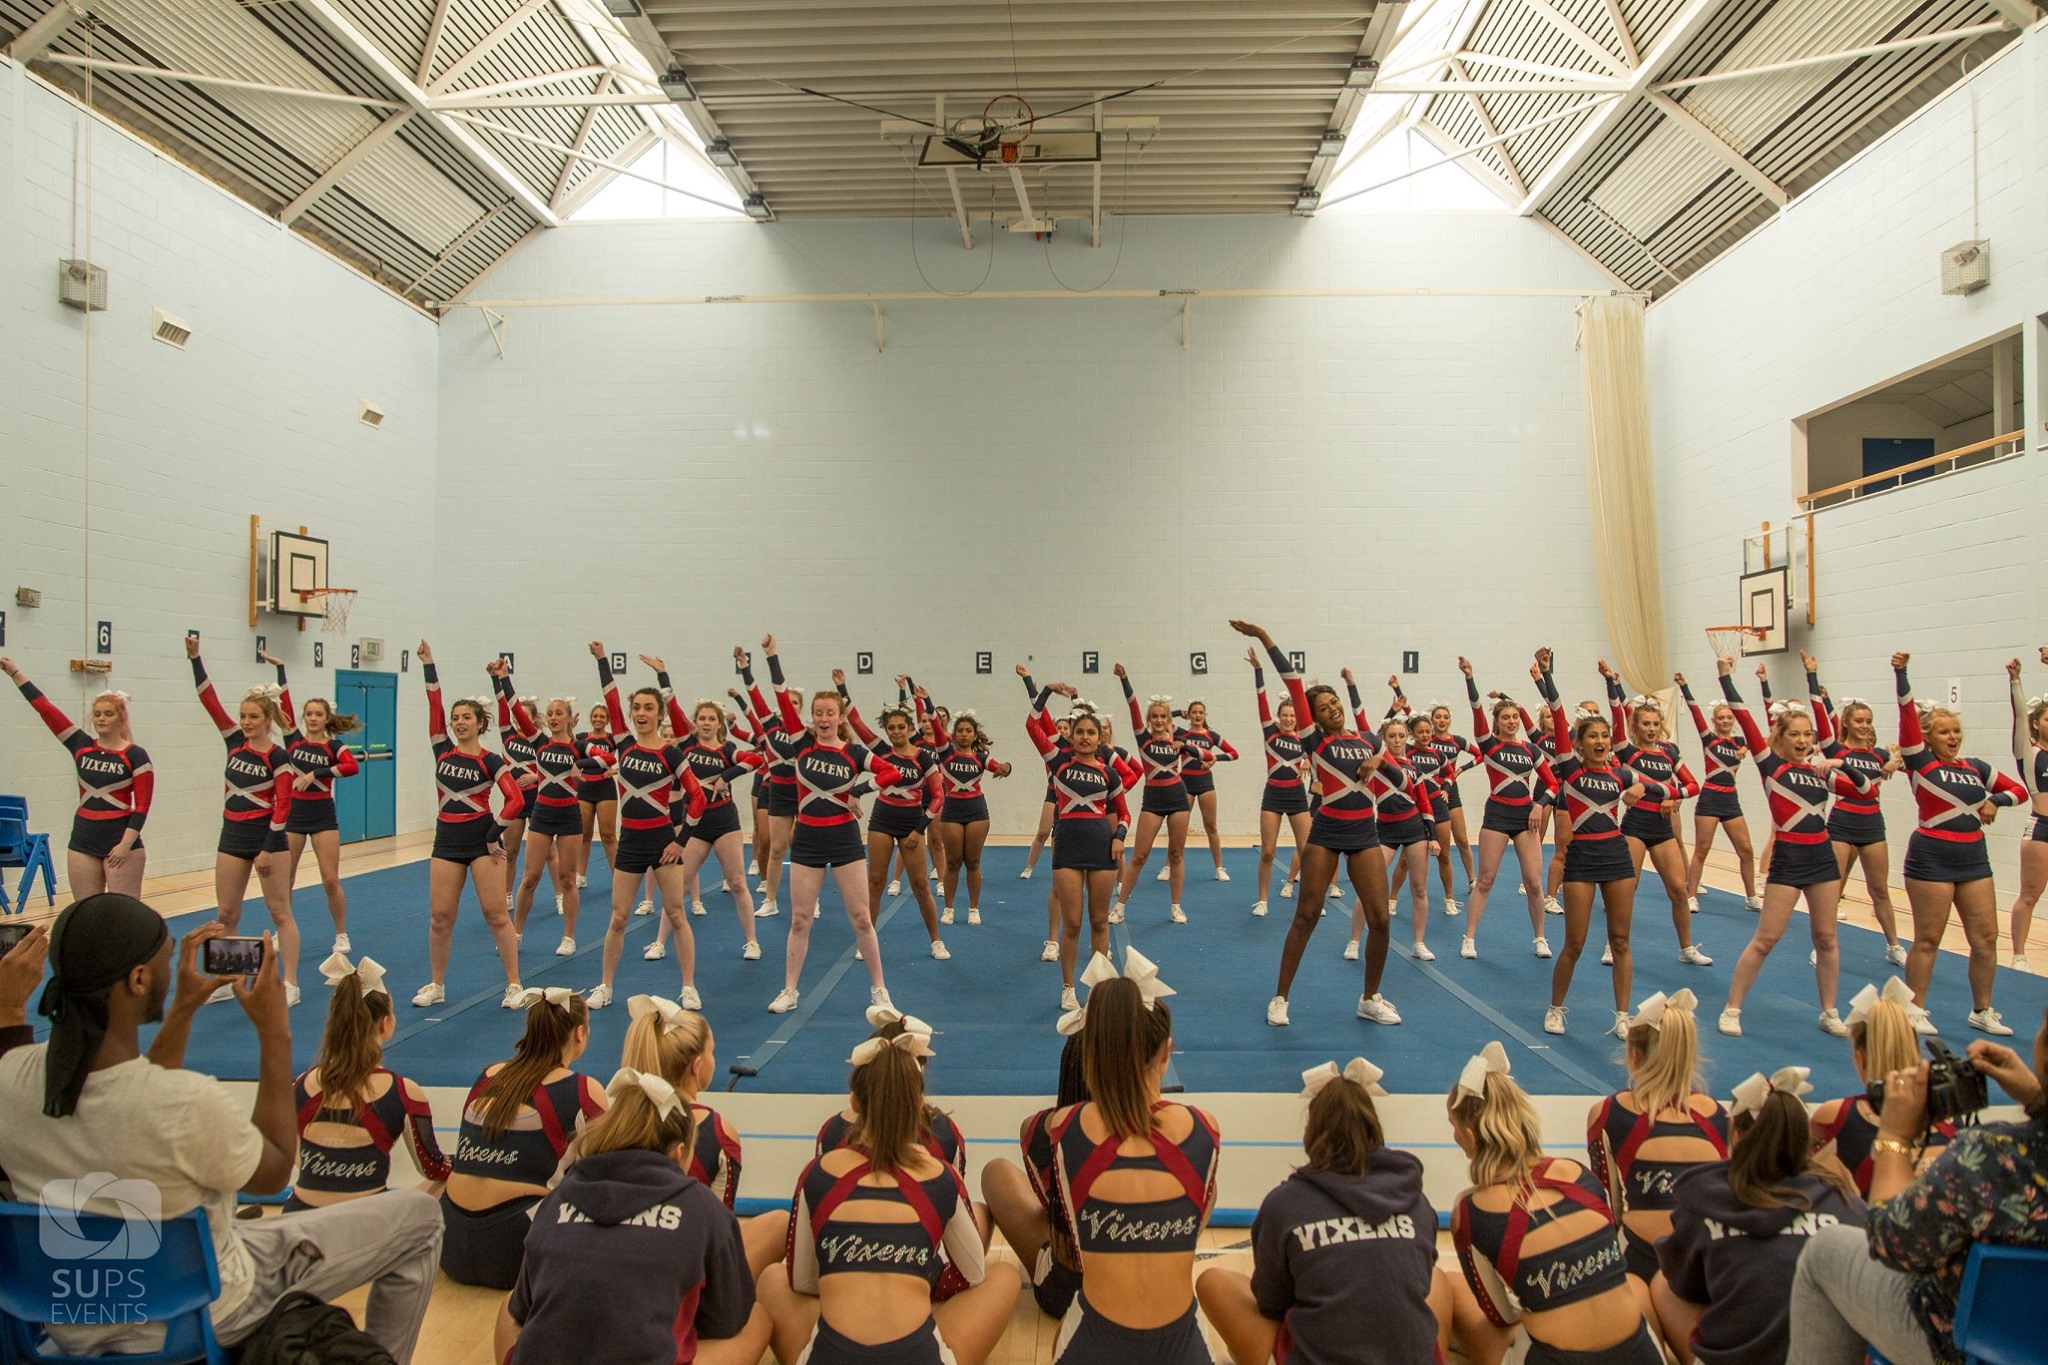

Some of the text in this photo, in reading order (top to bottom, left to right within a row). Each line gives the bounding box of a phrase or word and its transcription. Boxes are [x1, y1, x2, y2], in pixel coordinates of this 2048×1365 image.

[99, 625, 109, 646] 6
[315, 645, 322, 662] 3
[352, 647, 358, 664] 2
[402, 651, 407, 666] 1
[859, 655, 871, 669] D
[978, 654, 990, 669] E
[1085, 654, 1096, 669] F
[1192, 654, 1206, 670] G
[1291, 654, 1303, 669] H
[1408, 653, 1413, 669] I
[613, 655, 625, 670] B
[1950, 686, 1958, 703] 5
[80, 756, 125, 775] VIXENS
[293, 749, 329, 766] VIXENS
[541, 751, 575, 765] VIXENS
[622, 756, 663, 774] VIXENS
[686, 752, 725, 769] VIXENS
[228, 757, 267, 778] VIXENS
[438, 762, 480, 781] VIXENS
[805, 757, 850, 780] VIXENS
[950, 762, 979, 773] VIXENS
[1066, 769, 1106, 786] VIXENS
[1580, 777, 1619, 794] VIXENS
[301, 1148, 377, 1179] Vixens
[1080, 1208, 1197, 1242] Vixens
[1292, 1213, 1416, 1252] VIXENS
[821, 1234, 929, 1266] Vixens
[1527, 1240, 1620, 1299] Vixens
